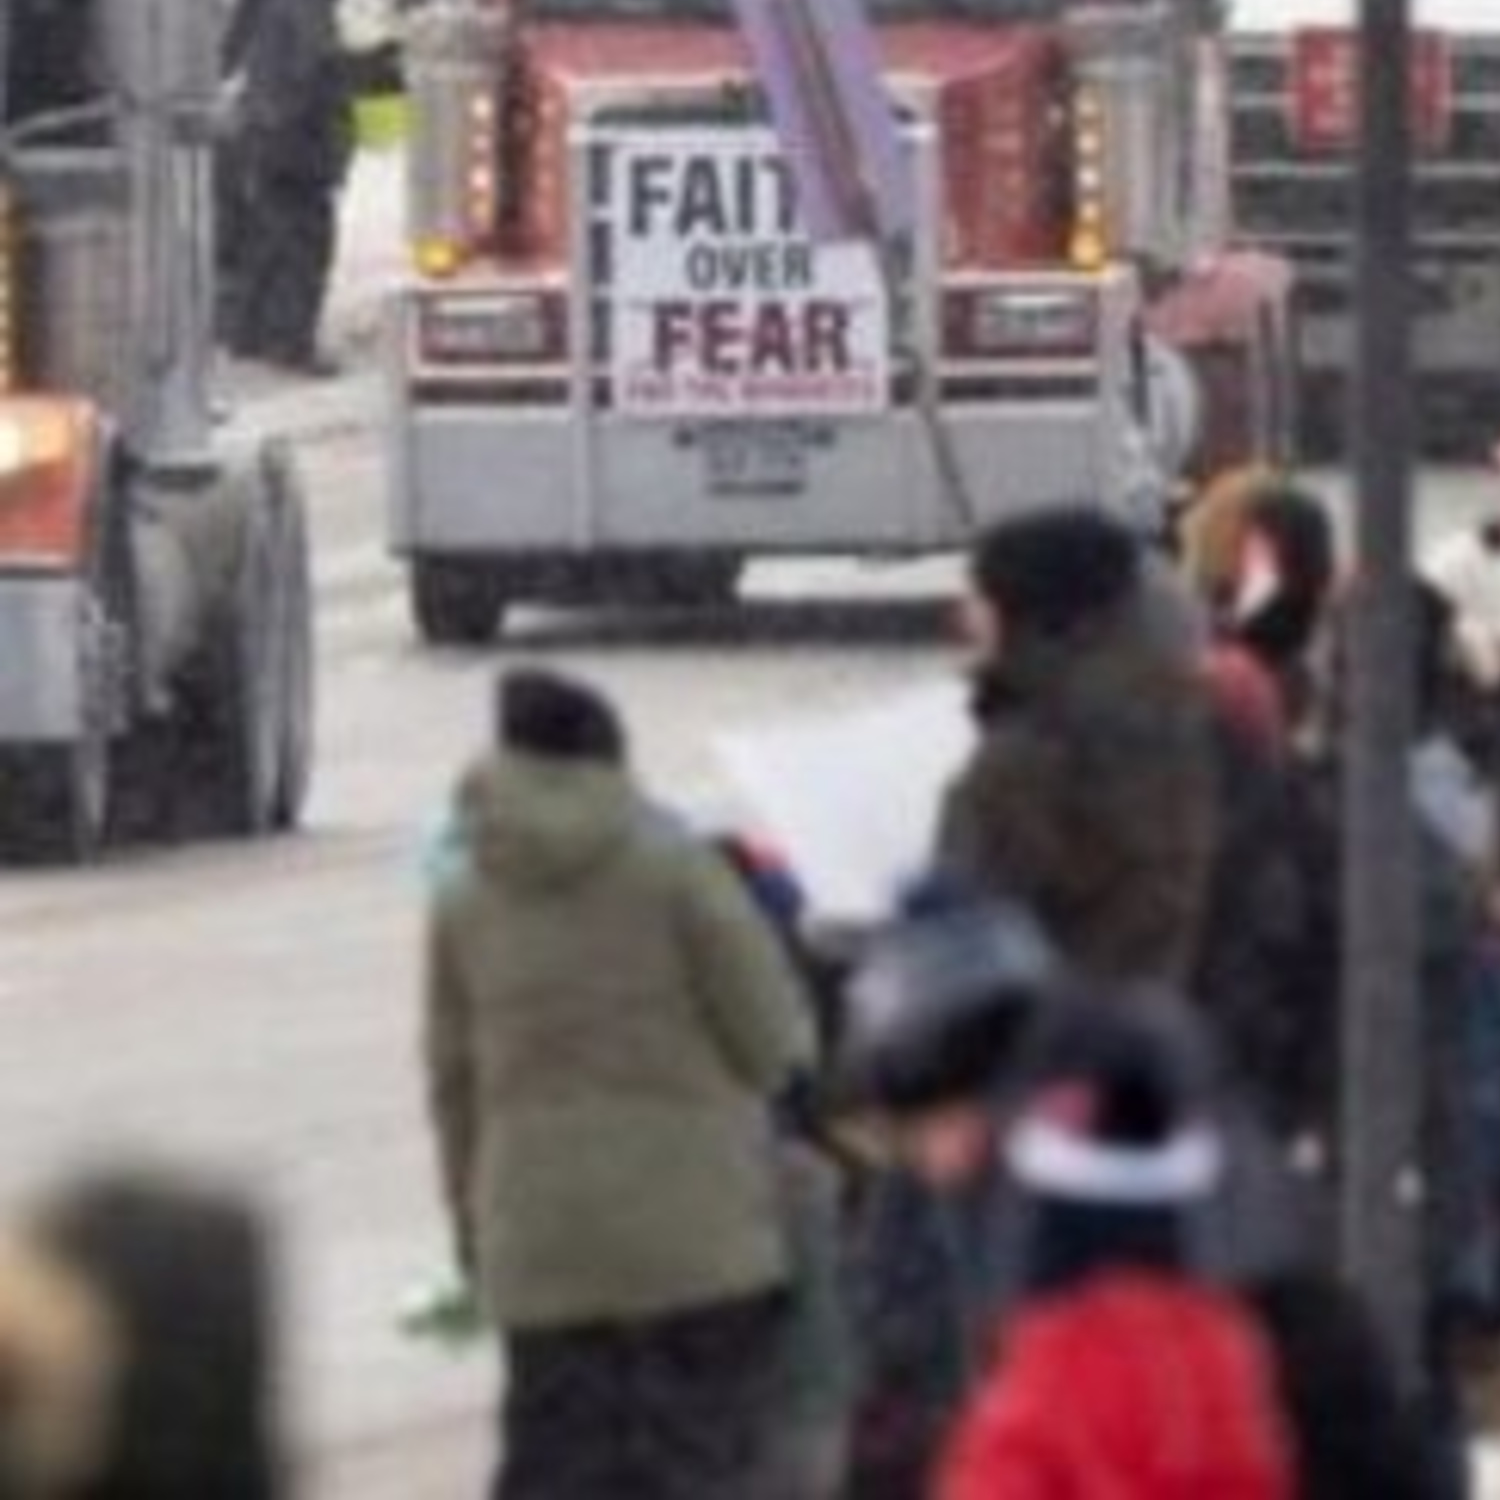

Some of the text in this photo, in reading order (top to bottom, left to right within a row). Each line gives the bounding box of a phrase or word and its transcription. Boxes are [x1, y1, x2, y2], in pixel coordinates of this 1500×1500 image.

[628, 155, 800, 237] FAIT
[686, 241, 813, 290] OVER
[652, 299, 850, 375] FEAR
